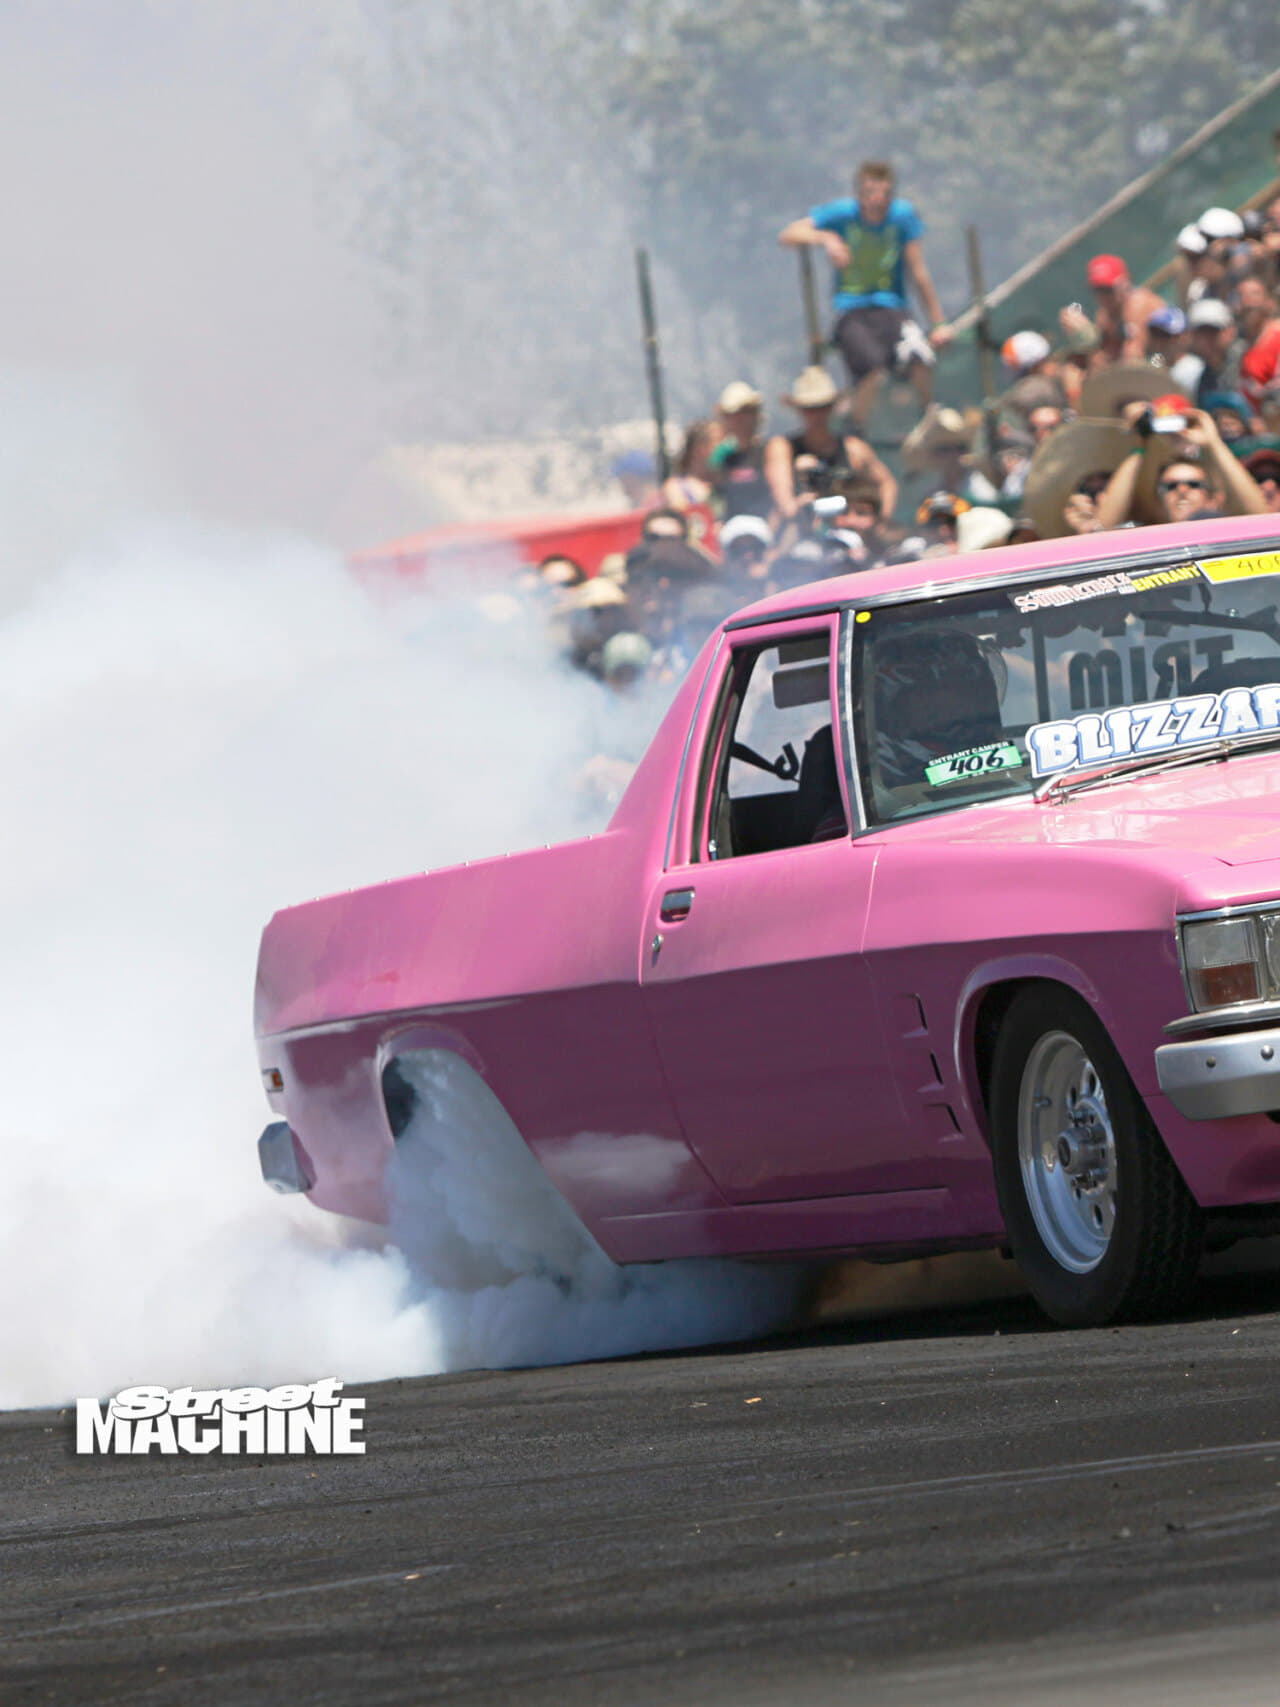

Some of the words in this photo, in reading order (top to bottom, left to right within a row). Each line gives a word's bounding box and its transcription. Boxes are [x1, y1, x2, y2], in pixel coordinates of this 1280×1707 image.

[1131, 563, 1201, 592] ENTRANT
[928, 749, 971, 766] ENTRANT
[971, 741, 1009, 755] CAMPER
[949, 748, 1004, 775] 406
